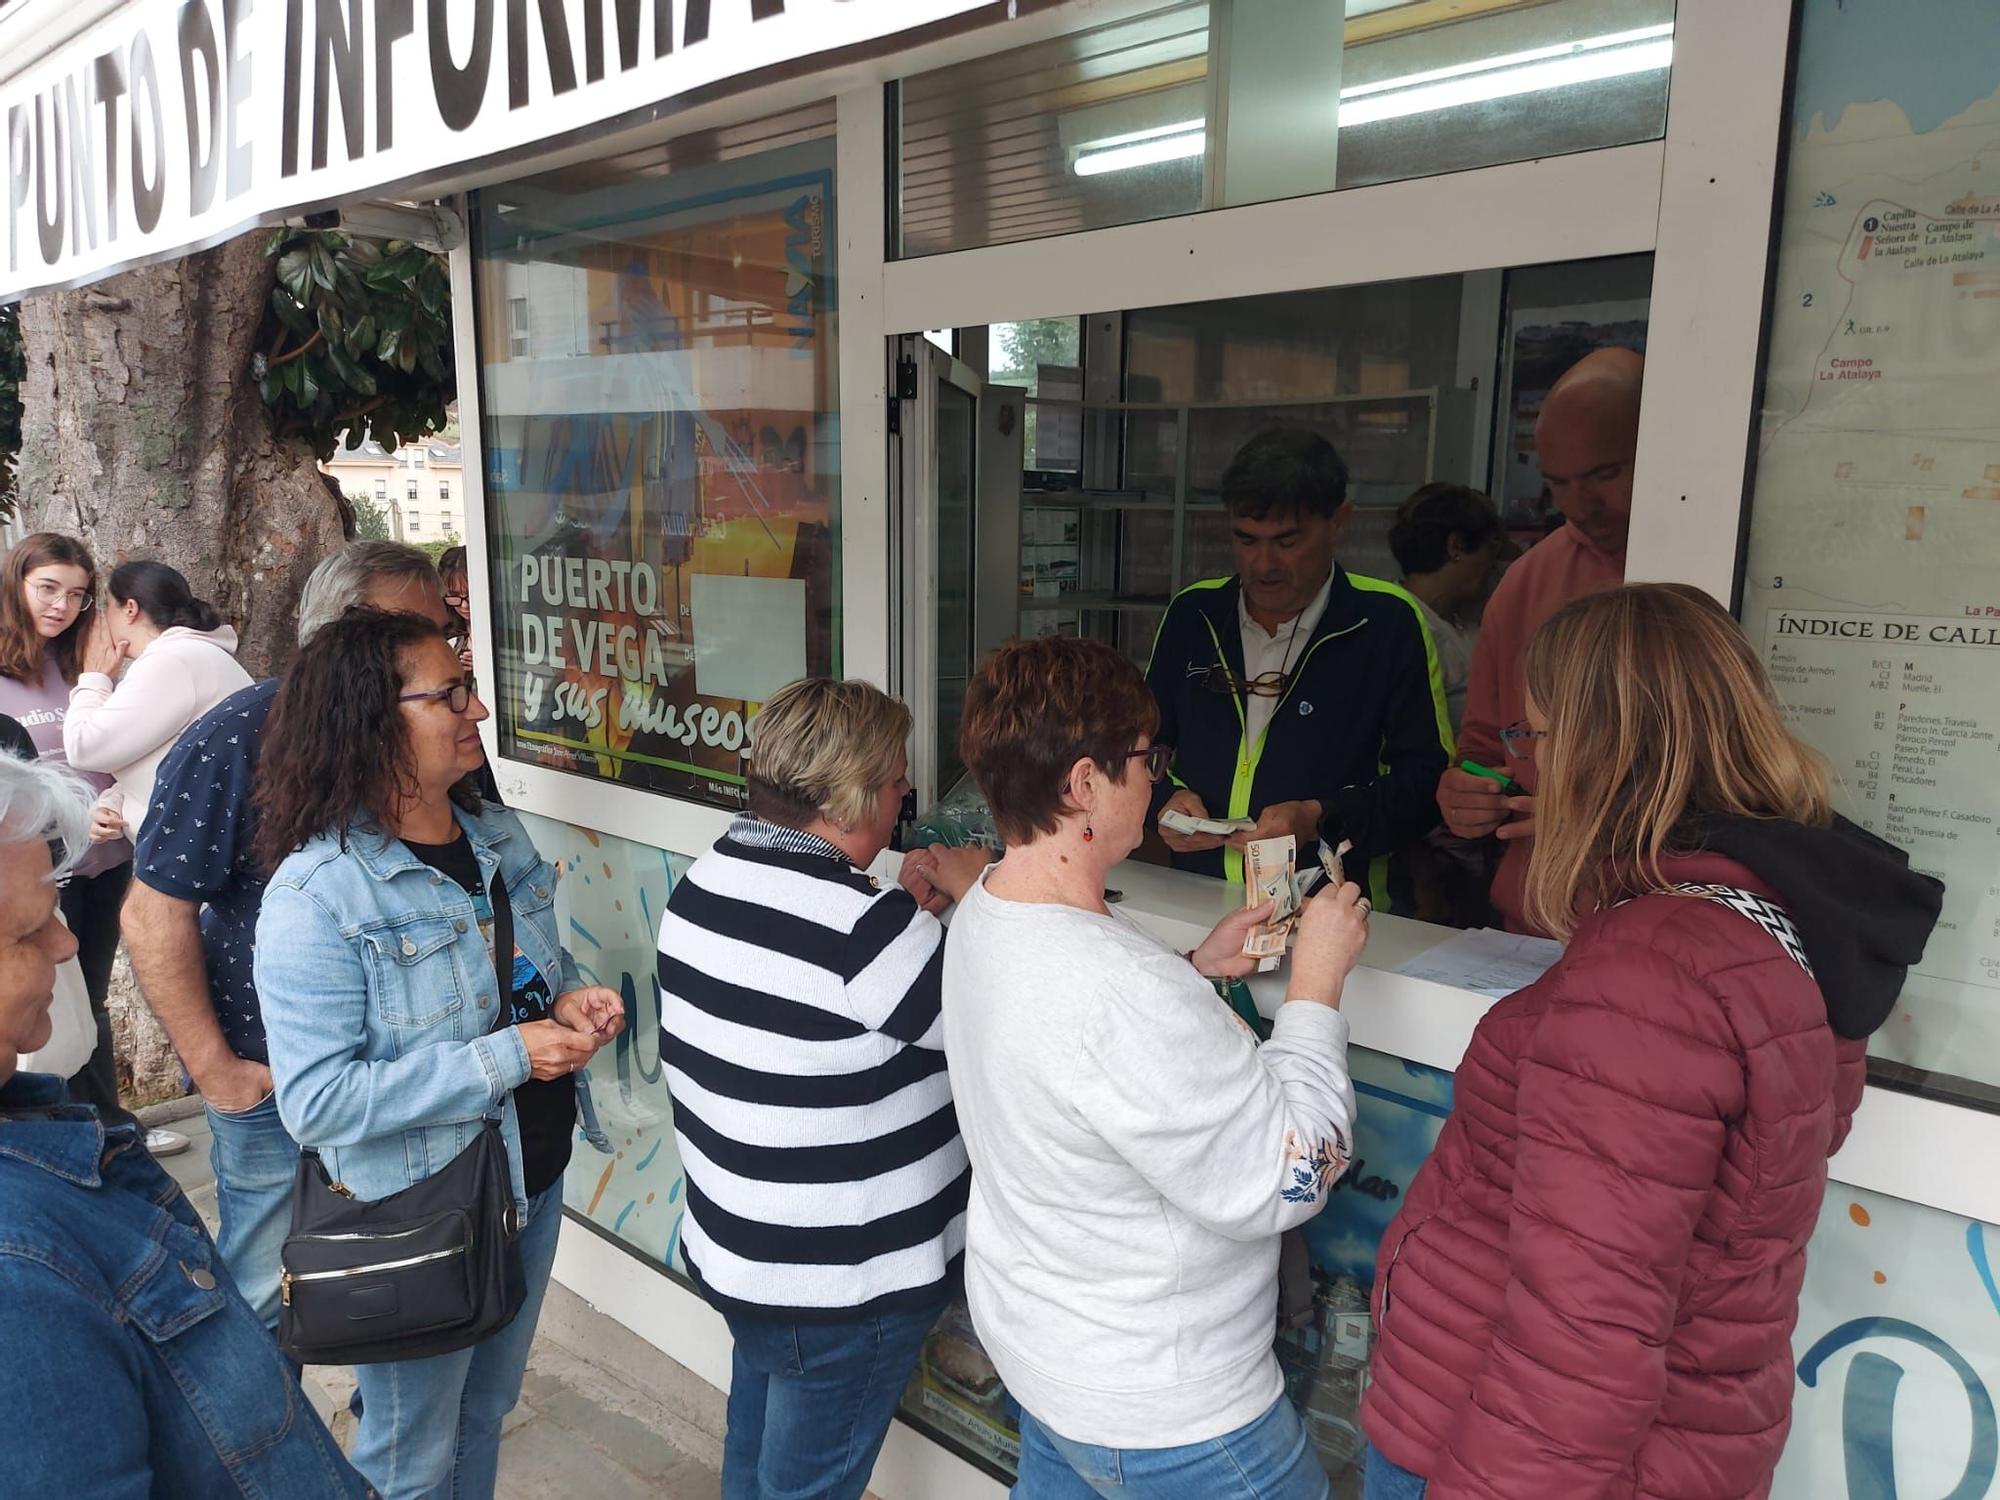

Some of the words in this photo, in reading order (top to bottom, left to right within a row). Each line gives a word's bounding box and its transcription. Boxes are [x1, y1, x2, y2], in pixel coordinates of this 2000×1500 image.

[8, 28, 166, 273] PUNTO
[178, 0, 252, 218] DE
[1883, 208, 1916, 222] Capilla
[809, 194, 822, 258] TURISMO
[1880, 222, 1916, 233] Nuestra
[1926, 222, 1960, 233] Campo
[1962, 219, 1975, 230] de
[1875, 234, 1906, 245] Señora
[1908, 233, 1919, 241] de
[1925, 235, 1937, 245] La
[1940, 233, 1973, 244] Atalaya
[1886, 245, 1917, 257] Atalaya
[1904, 258, 1924, 269] Calle
[1926, 256, 1937, 266] de
[1939, 255, 1949, 264] La
[1951, 250, 1985, 262] Atalaya
[1802, 294, 1813, 308] 2
[1830, 358, 1873, 369] Campo
[1820, 370, 1834, 381] La
[1838, 369, 1882, 381] Atalaya
[521, 553, 657, 617] PUERTO
[1772, 576, 1783, 590] 3
[1965, 605, 1981, 616] La
[1776, 613, 1875, 639] ÍNDICE
[1882, 623, 1921, 641] DE
[1928, 625, 2000, 646] CALL
[521, 613, 567, 670] DE
[571, 617, 669, 687] VEGA
[1771, 644, 1778, 652] A
[1903, 662, 1914, 672] M
[1903, 673, 1933, 683] Madrid
[524, 671, 543, 722] y
[552, 681, 608, 729] sus
[1899, 703, 1906, 711] P
[1941, 727, 1968, 738] García
[1895, 743, 1919, 754] Paseo
[1920, 745, 1950, 757] Fuente
[1915, 766, 1926, 776] La
[1891, 773, 1936, 787] Pescadores
[723, 785, 740, 798] INFO
[1889, 793, 1896, 802] R
[1887, 803, 1917, 815] Ramón
[1905, 836, 1915, 845] La
[1947, 831, 1958, 840] de
[1250, 843, 1261, 858] 50
[1268, 887, 1278, 897] 5
